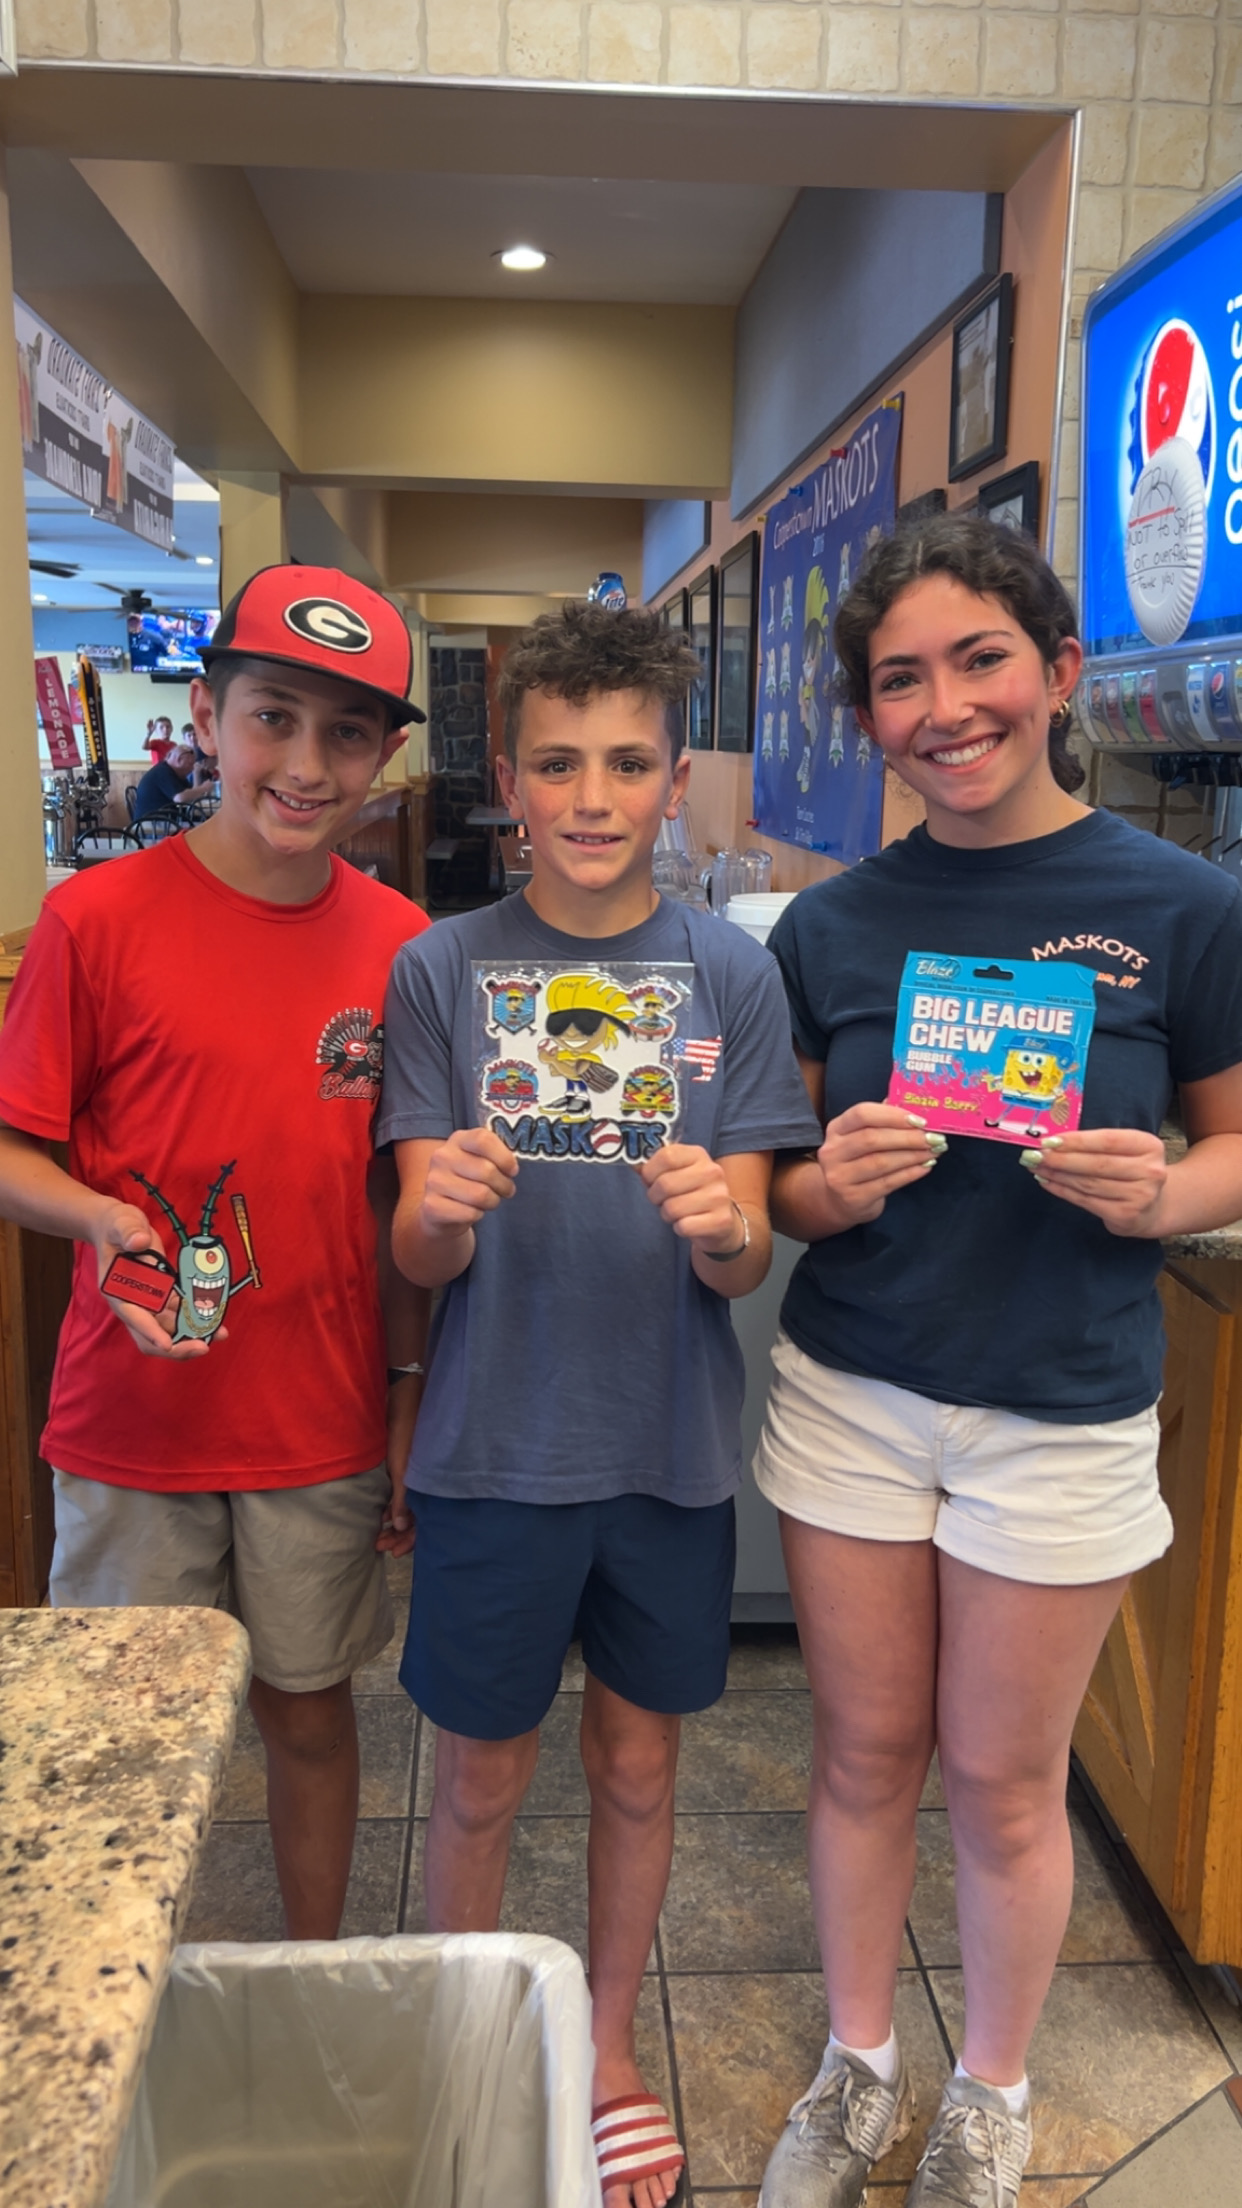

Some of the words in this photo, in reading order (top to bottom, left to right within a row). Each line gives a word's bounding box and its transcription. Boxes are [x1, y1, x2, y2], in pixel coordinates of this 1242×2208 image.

[811, 422, 879, 534] MASKOTS
[1137, 466, 1179, 522] TRY
[45, 678, 69, 759] LEMONADE
[1031, 934, 1150, 970] MASKOTS
[911, 994, 962, 1022] BIG
[964, 999, 1074, 1035] LEAGUE
[906, 1049, 953, 1065] BUBBLE
[908, 1022, 998, 1054] CHEW
[905, 1060, 936, 1073] GUM
[491, 1114, 667, 1159] MASKOTS
[110, 1272, 165, 1299] COOPERSTOWN
